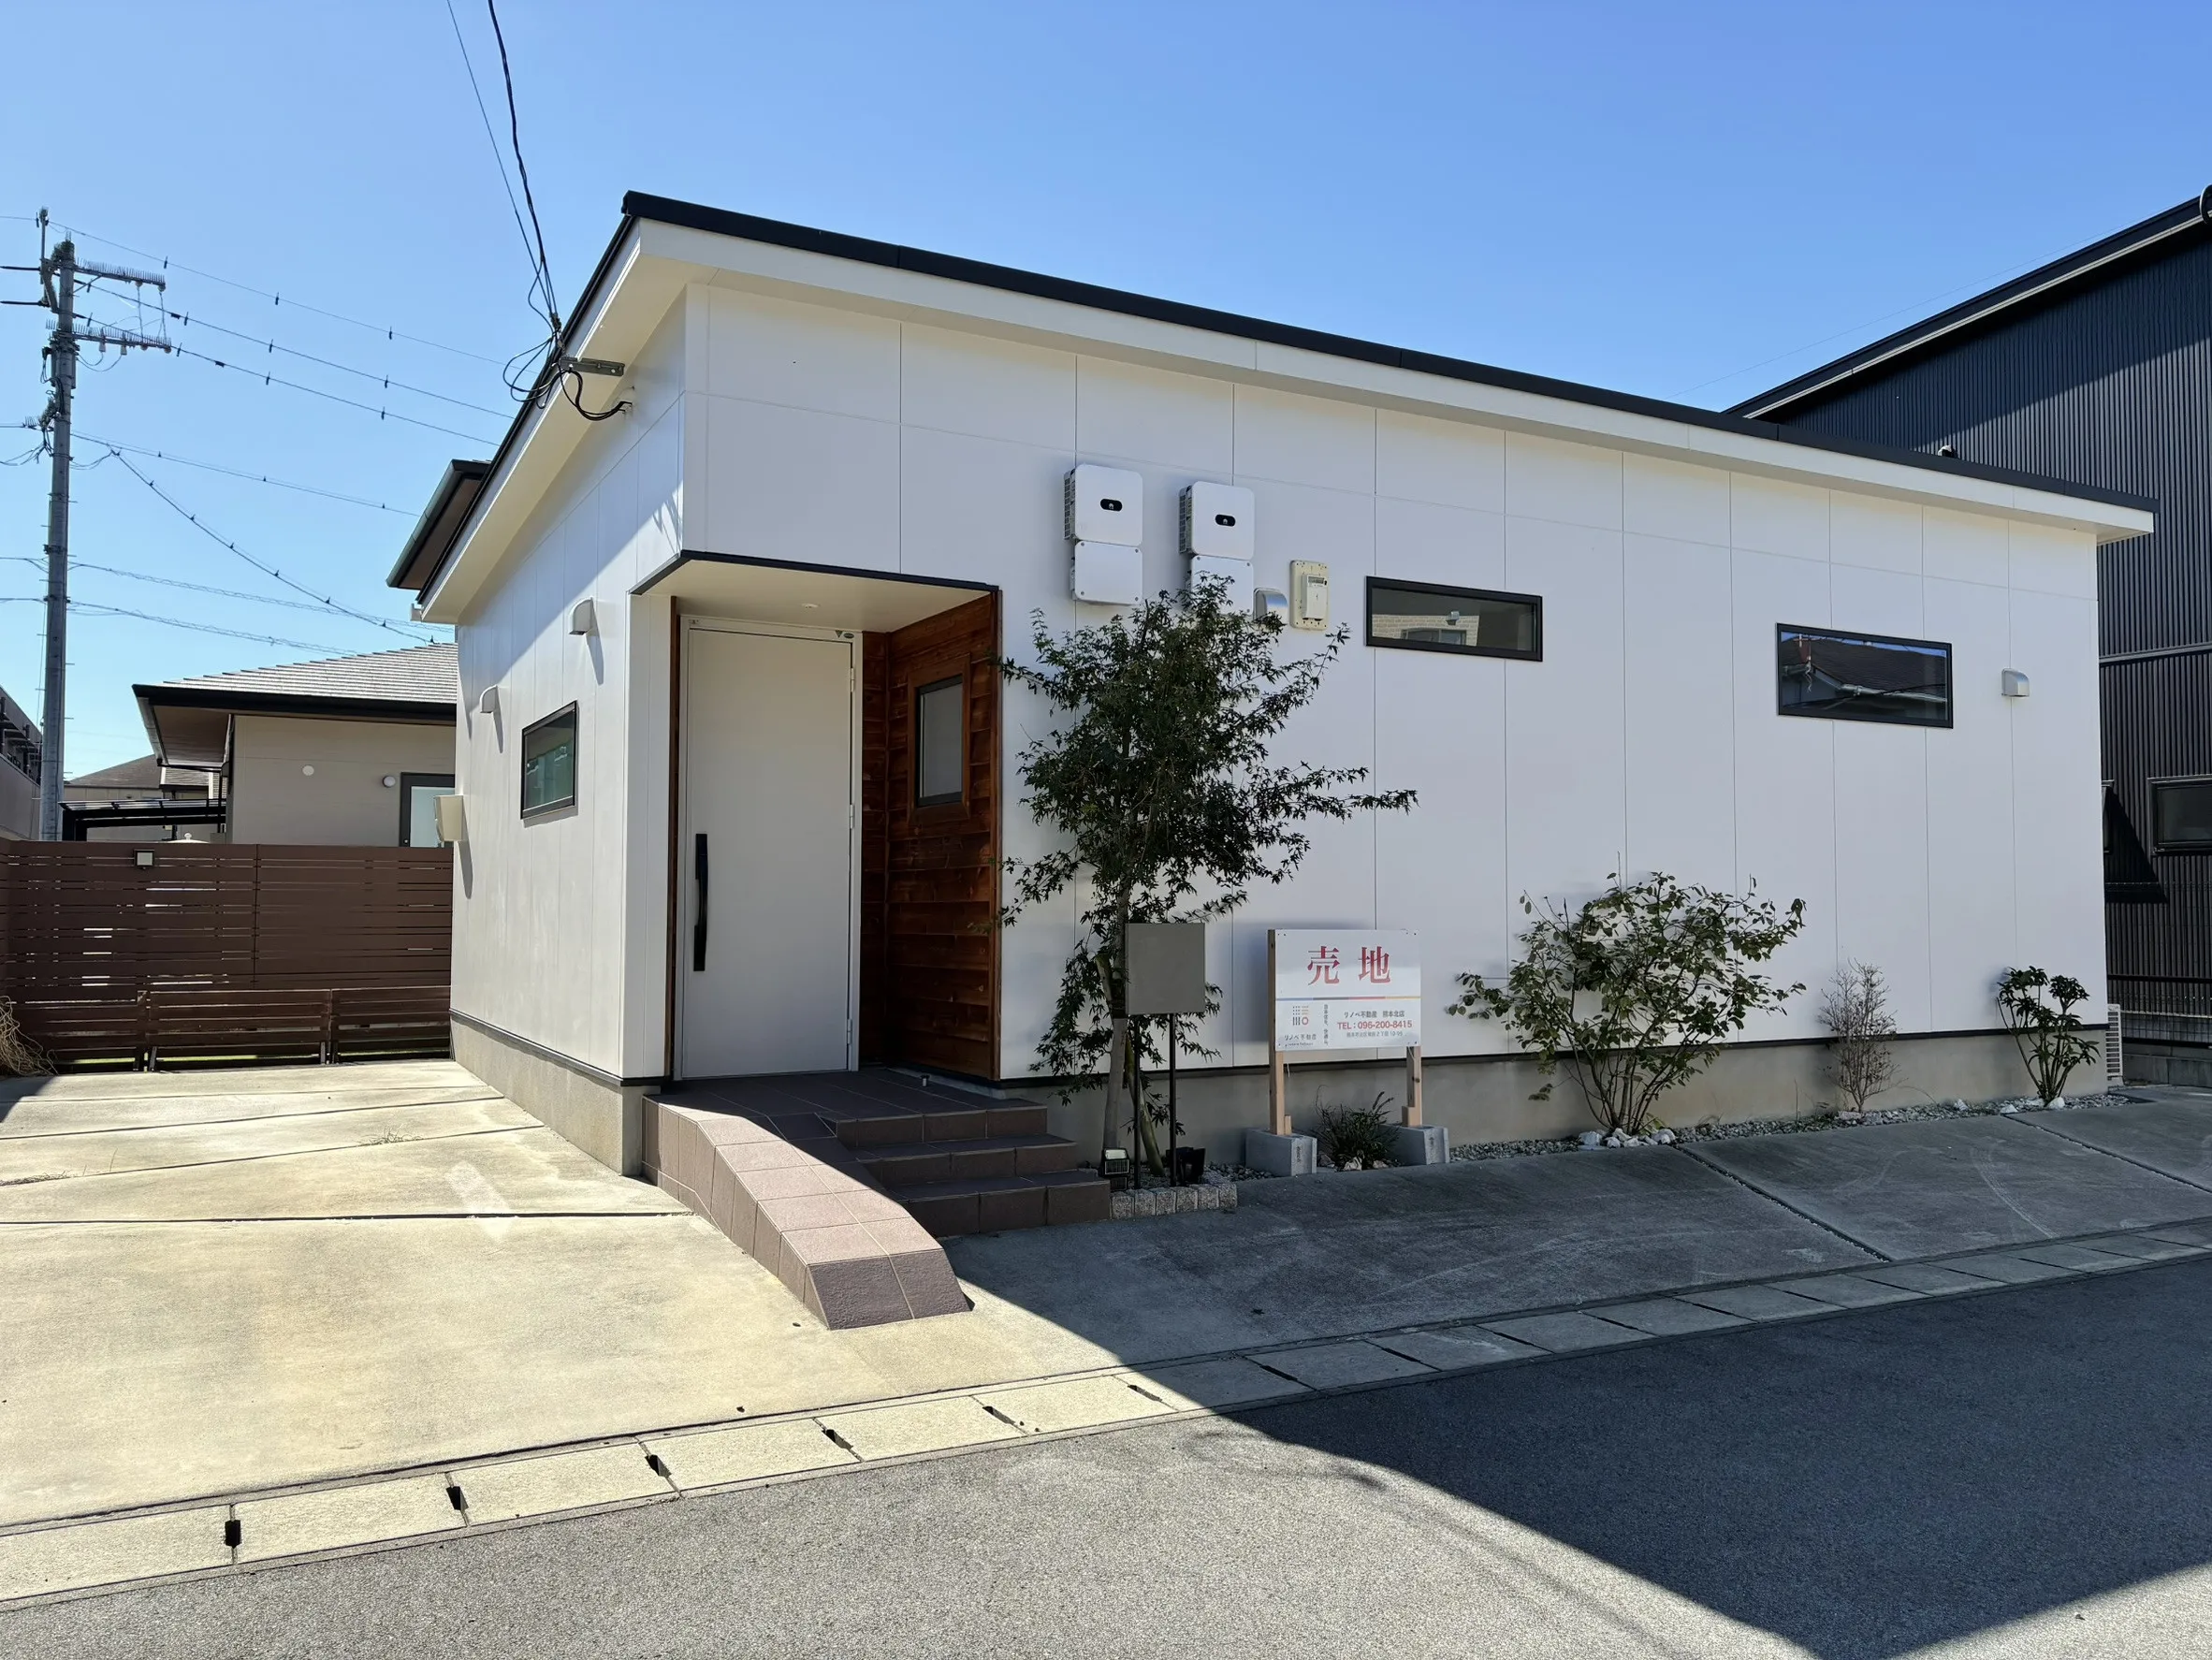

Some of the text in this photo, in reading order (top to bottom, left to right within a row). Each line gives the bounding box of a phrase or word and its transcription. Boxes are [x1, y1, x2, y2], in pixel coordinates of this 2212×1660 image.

[1307, 945, 1391, 985] 売地
[1344, 1011, 1377, 1019] リノベ不動産
